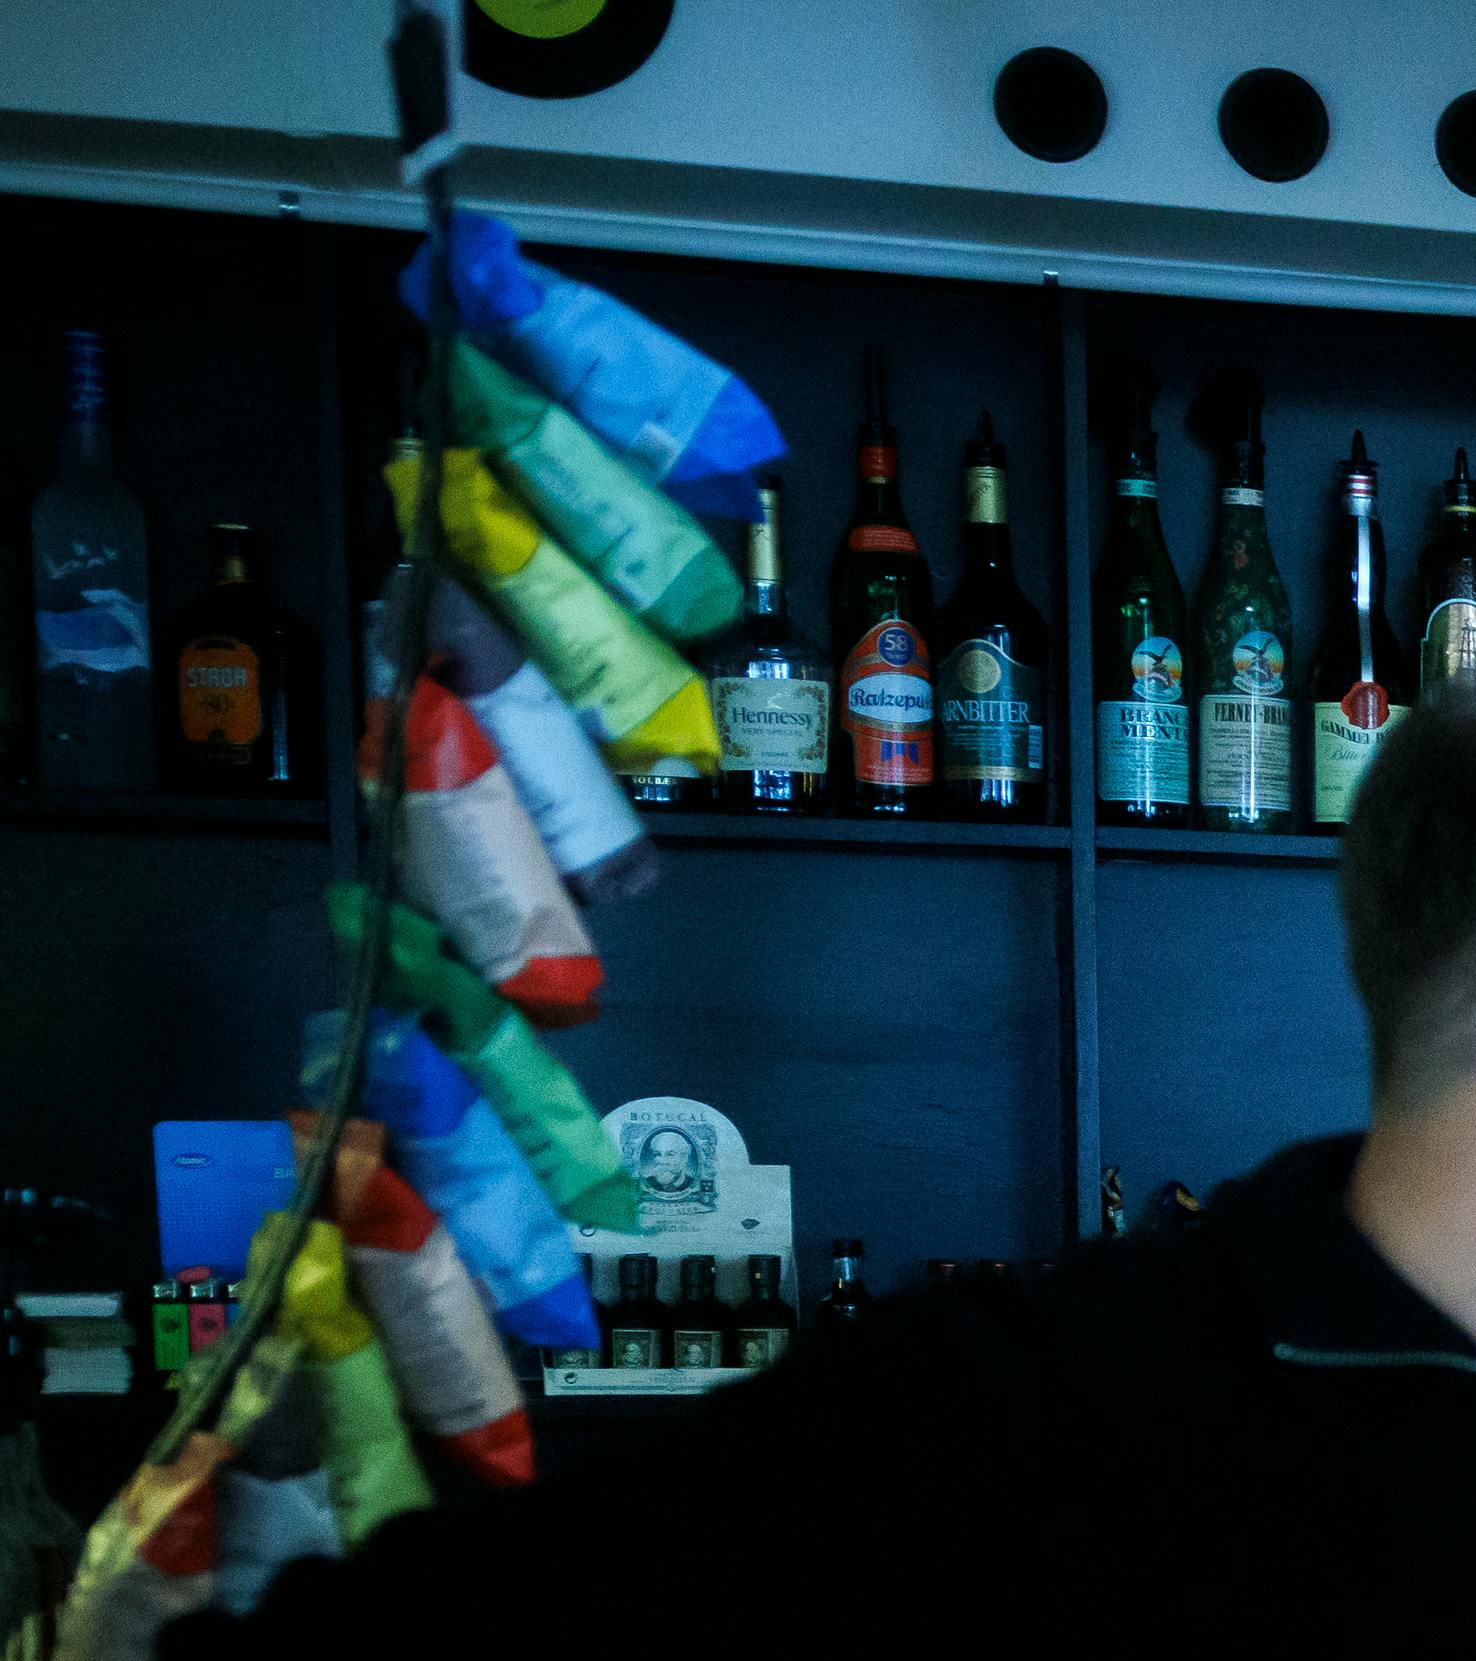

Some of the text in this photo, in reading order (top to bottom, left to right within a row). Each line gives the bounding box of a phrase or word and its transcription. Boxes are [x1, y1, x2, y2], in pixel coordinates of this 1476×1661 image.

[883, 633, 909, 652] 58
[732, 706, 814, 730] Hennessy
[1120, 724, 1185, 740] MENT
